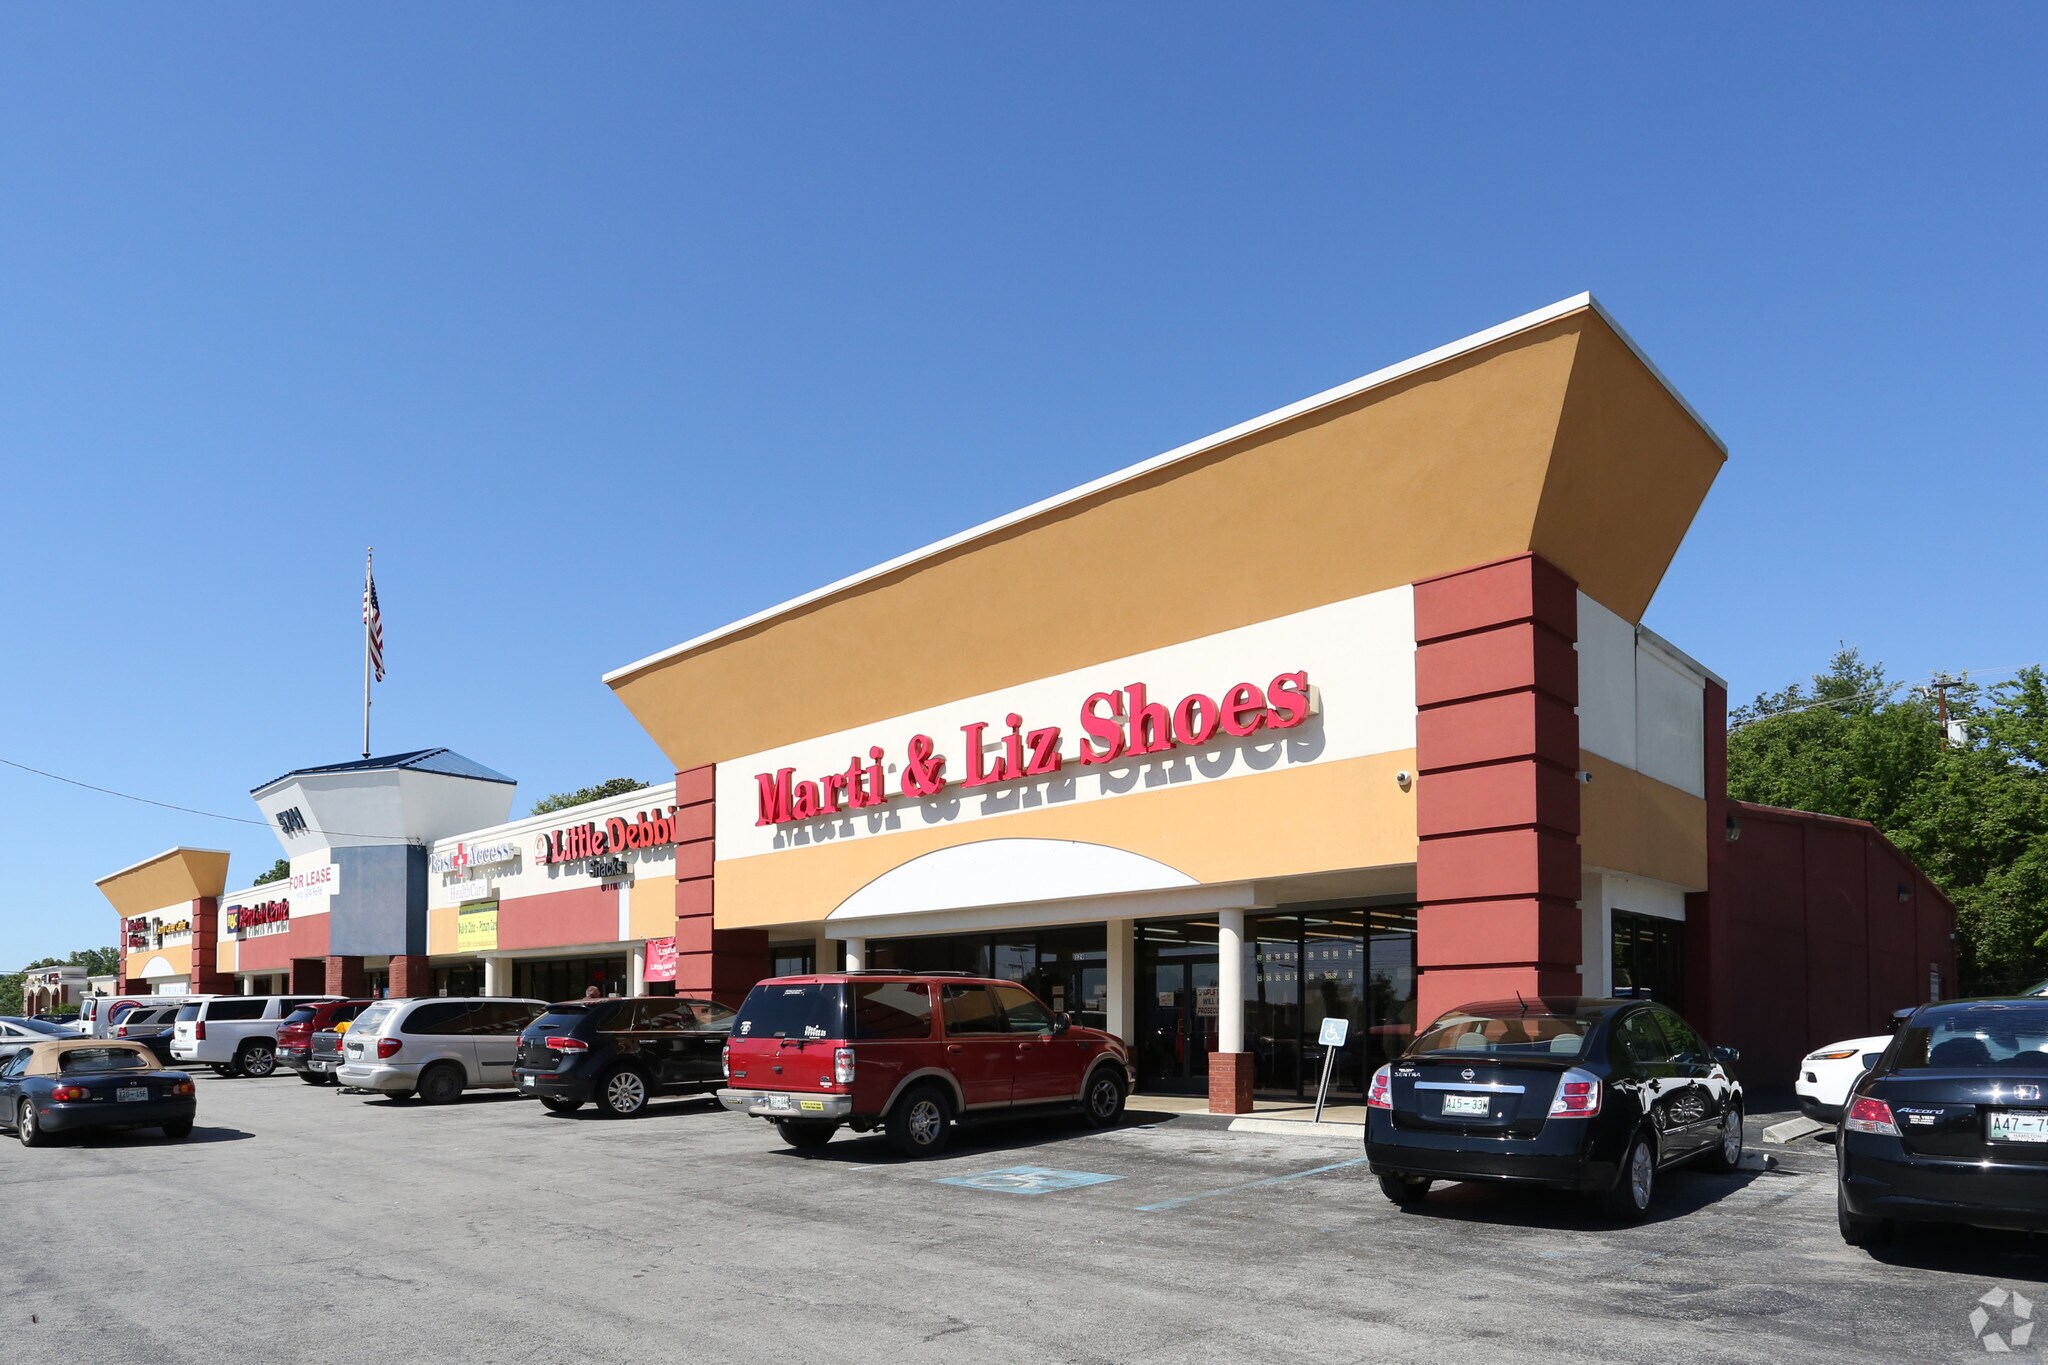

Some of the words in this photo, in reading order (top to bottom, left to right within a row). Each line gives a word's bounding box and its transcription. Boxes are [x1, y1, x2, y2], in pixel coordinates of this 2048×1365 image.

[755, 745, 887, 827] Marti
[901, 734, 947, 798] &
[960, 712, 1062, 789] Liz
[1080, 670, 1309, 766] Shoes
[552, 822, 607, 863] Little
[606, 806, 677, 854] Debbi
[290, 874, 304, 890] FOR
[306, 866, 331, 886] LEASE
[590, 858, 626, 877] Snacks
[239, 900, 289, 928] Rent-A-Cente
[1897, 1107, 1945, 1115] Accord
[1993, 1117, 2048, 1132] A47-7
